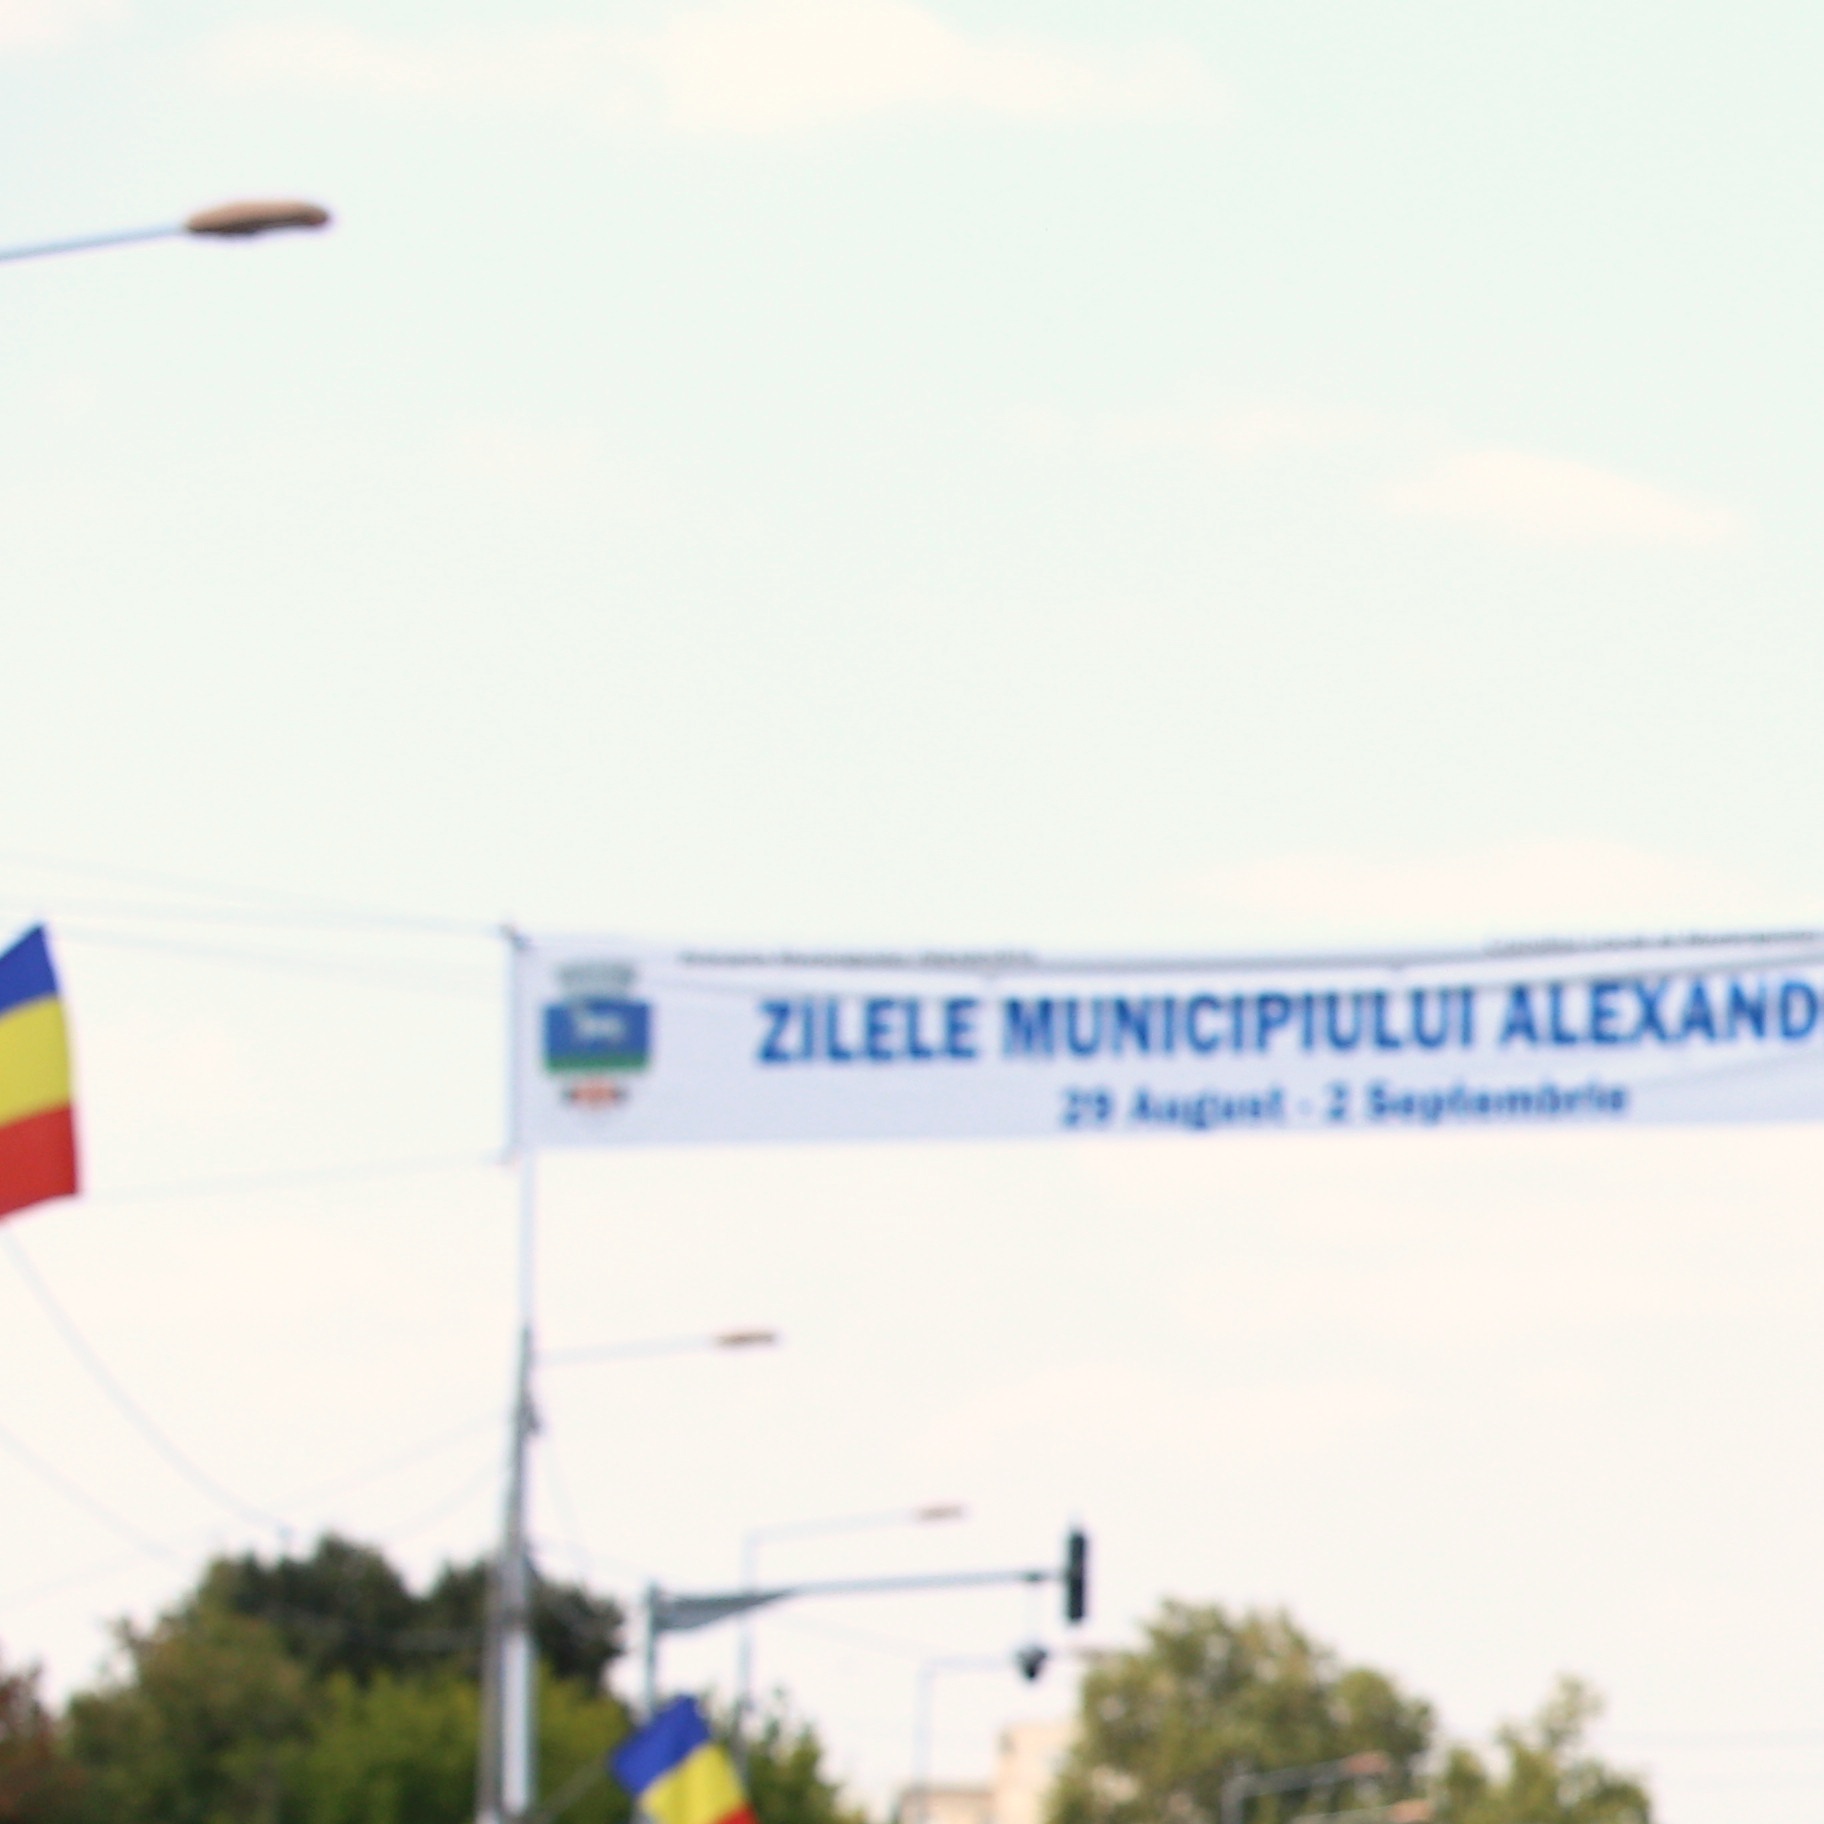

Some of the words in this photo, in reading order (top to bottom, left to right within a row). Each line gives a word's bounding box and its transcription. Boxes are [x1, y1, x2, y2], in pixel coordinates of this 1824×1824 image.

[757, 996, 982, 1064] ZILELE
[1001, 985, 1476, 1060] MUNICIPIULUI
[1061, 1084, 1114, 1128] 29
[1130, 1080, 1286, 1131] August
[1324, 1077, 1350, 1124] 2
[1364, 1076, 1627, 1127] Septembrie
